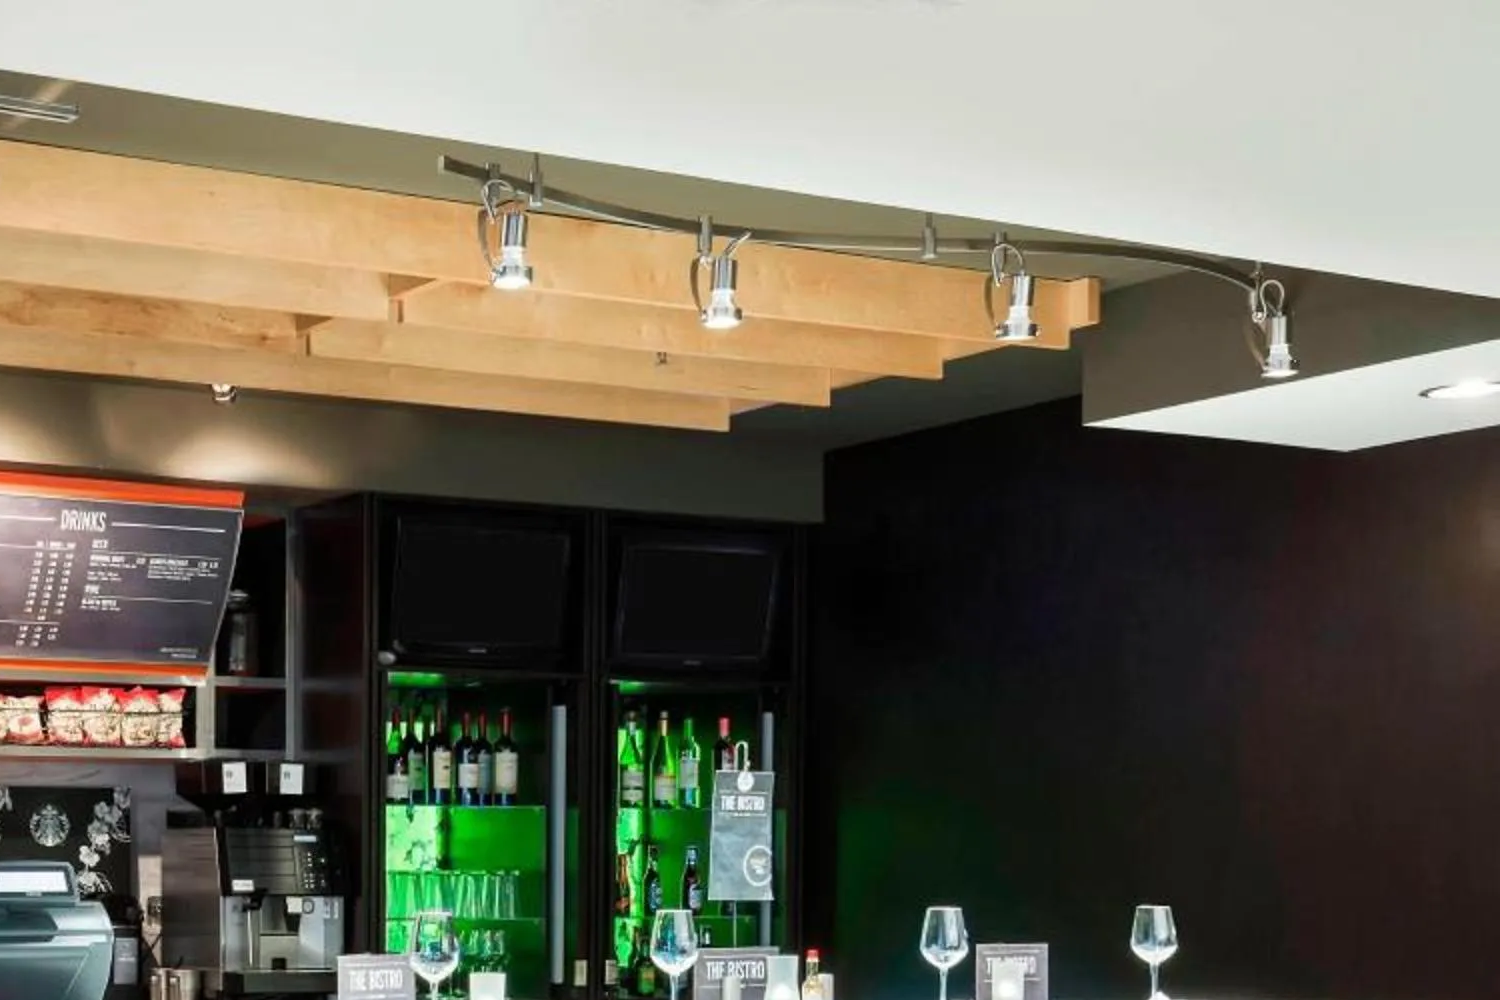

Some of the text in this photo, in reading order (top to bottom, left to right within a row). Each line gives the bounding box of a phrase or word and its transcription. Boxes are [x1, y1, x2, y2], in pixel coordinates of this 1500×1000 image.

[60, 509, 107, 532] DRINKS
[720, 795, 766, 811] THE BISTRO
[349, 968, 404, 992] THE BISTRO
[706, 959, 765, 980] THE BISTRO
